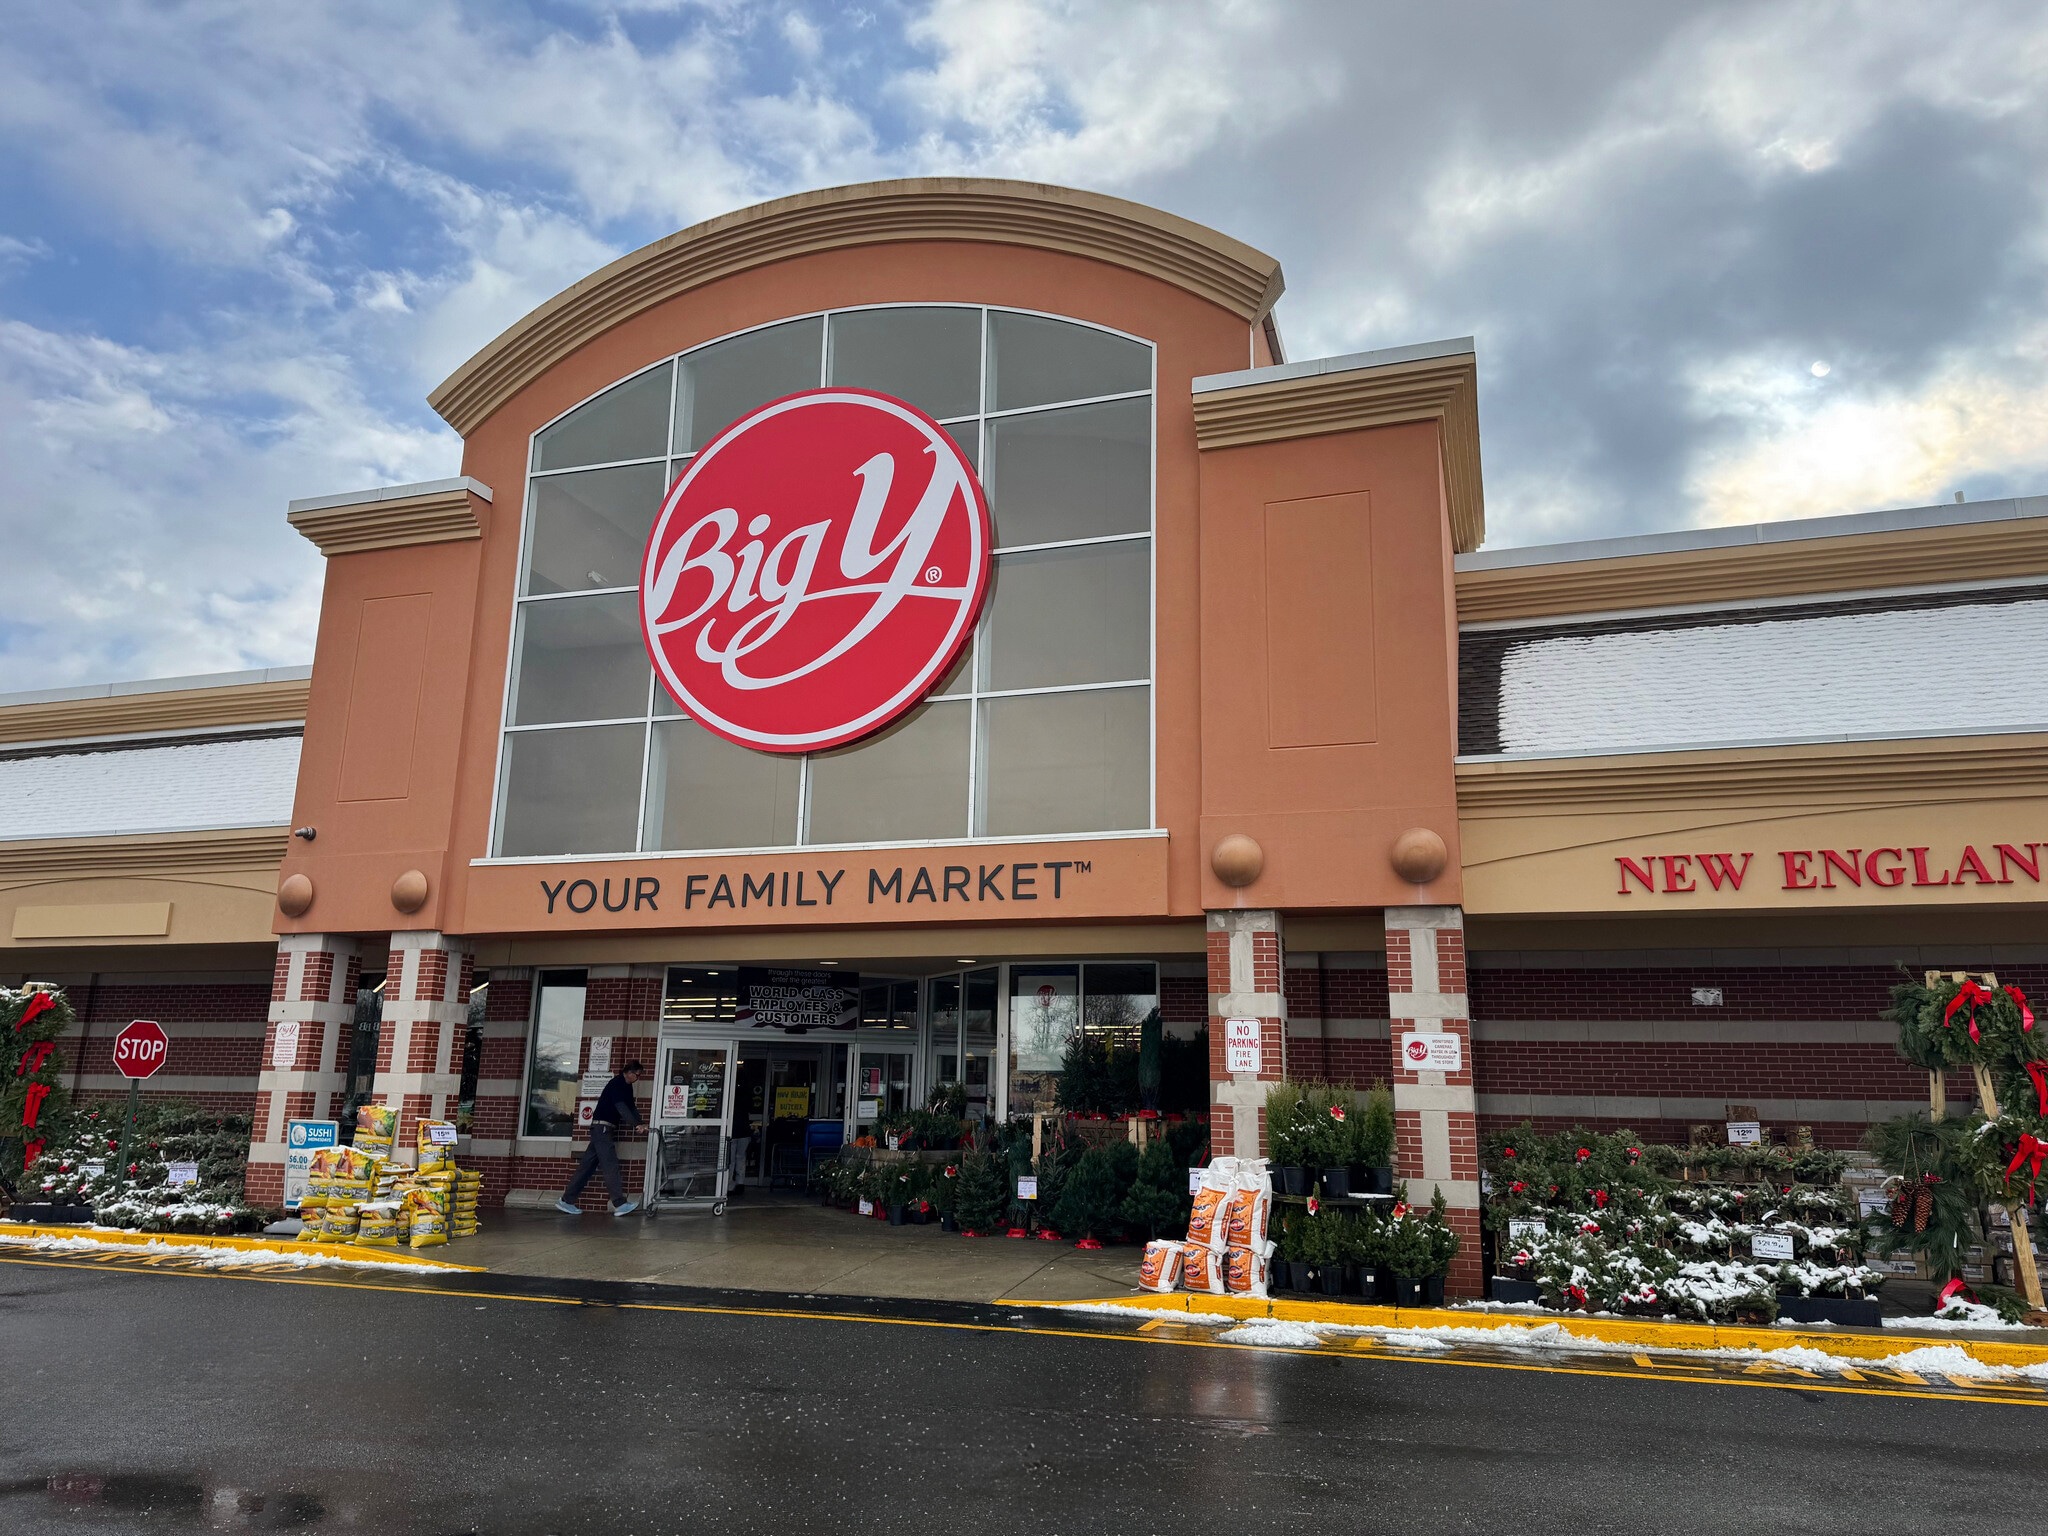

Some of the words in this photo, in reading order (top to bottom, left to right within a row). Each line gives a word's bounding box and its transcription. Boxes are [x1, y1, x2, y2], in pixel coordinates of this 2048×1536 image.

[653, 507, 832, 664] Big
[1614, 852, 1754, 894] NEW
[1777, 842, 2048, 890] ENGLAN
[540, 876, 661, 914] YOUR
[684, 869, 846, 910] FAMILY
[749, 985, 798, 998] WORLD
[801, 987, 844, 1000] CLASS
[749, 998, 829, 1012] EMPLOYEES
[832, 1001, 843, 1013] &
[754, 1011, 837, 1025] CUSTOMERS
[1236, 1025, 1250, 1036] NO
[118, 1037, 164, 1061] STOP
[1228, 1038, 1258, 1049] PARKING
[1235, 1050, 1251, 1058] FIRE
[1234, 1060, 1252, 1068] LANE
[308, 1128, 332, 1138] SUSHI
[289, 1155, 308, 1164] $6.00
